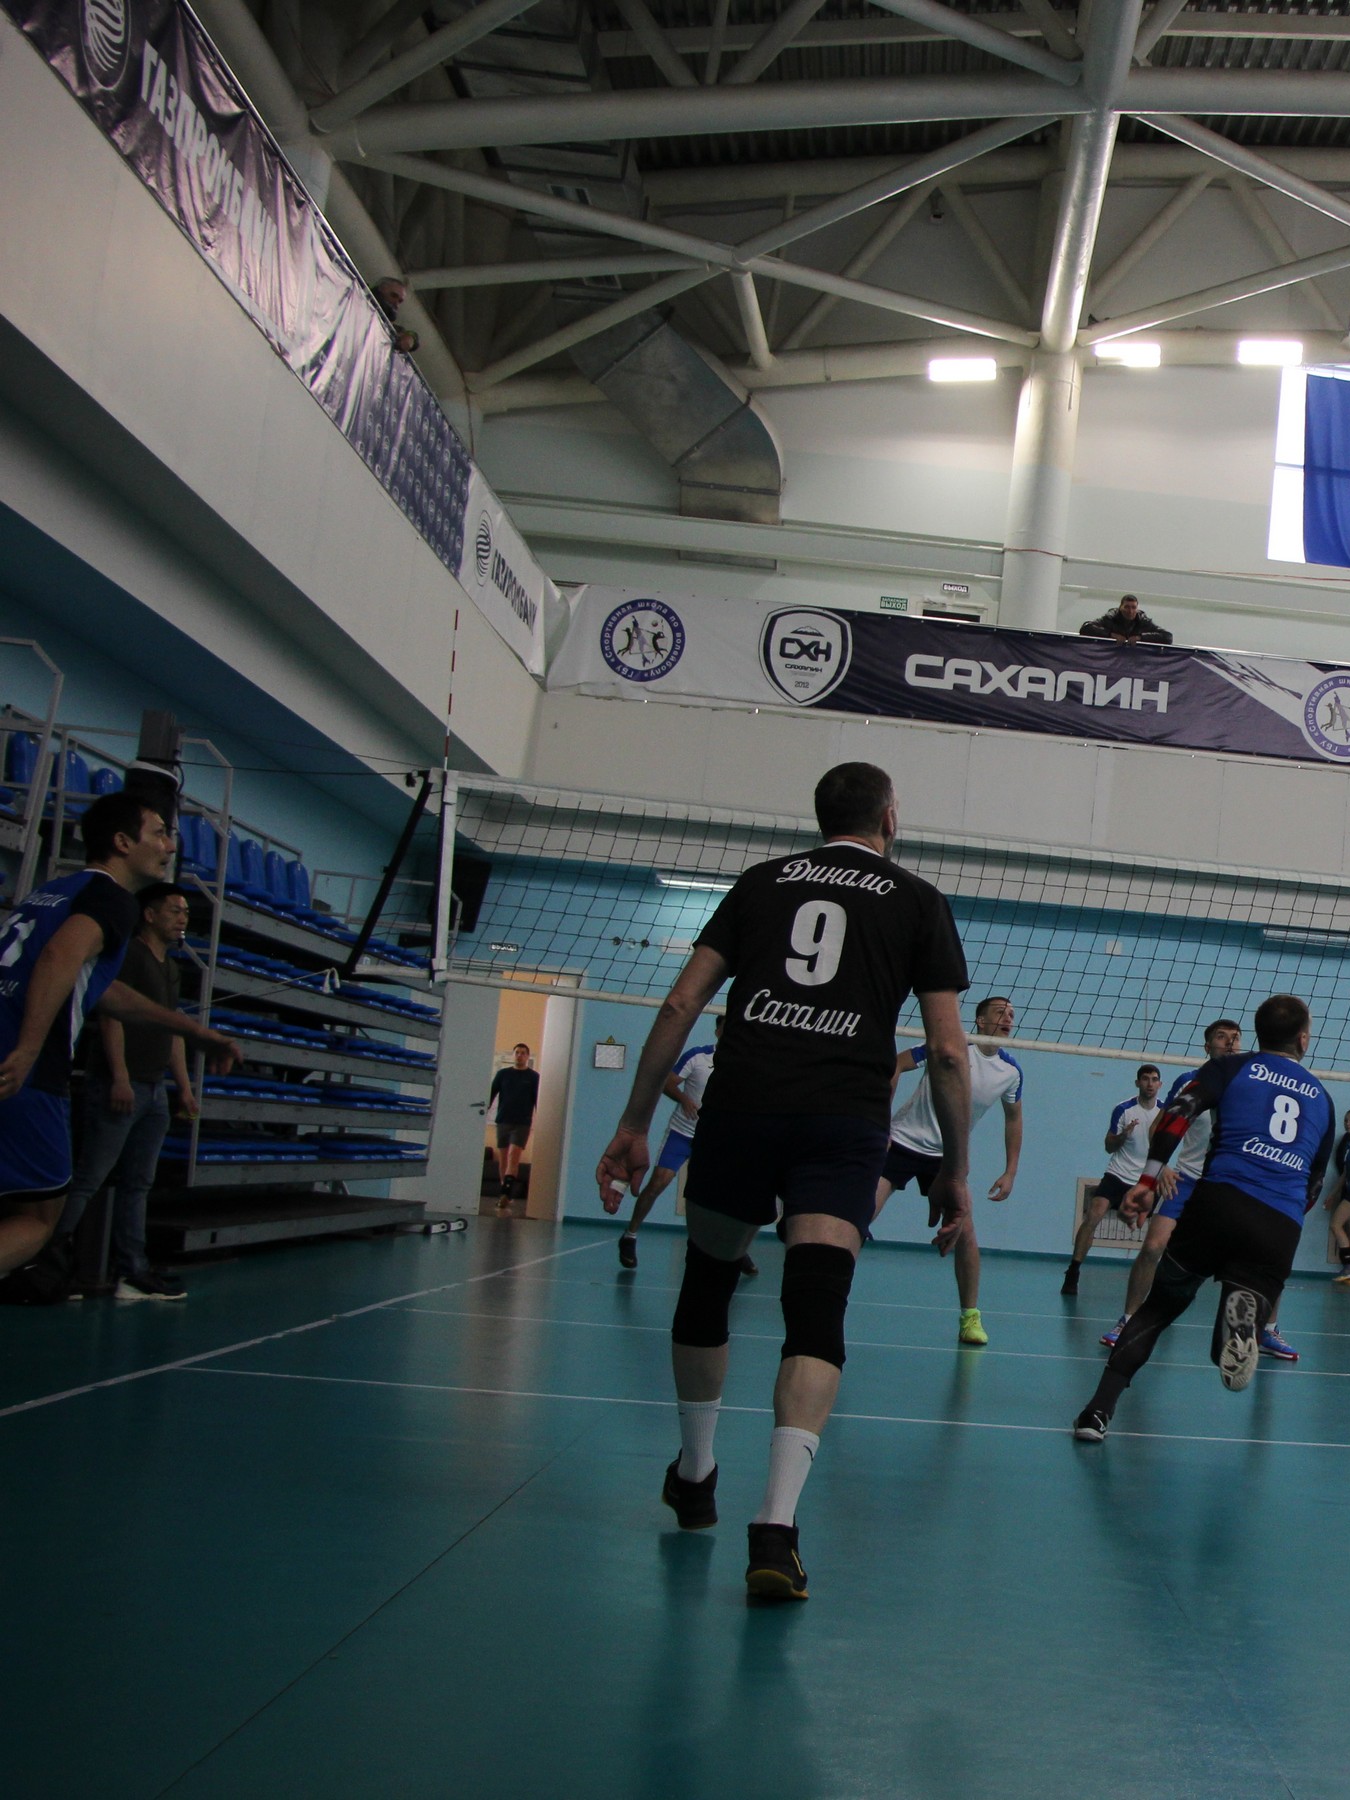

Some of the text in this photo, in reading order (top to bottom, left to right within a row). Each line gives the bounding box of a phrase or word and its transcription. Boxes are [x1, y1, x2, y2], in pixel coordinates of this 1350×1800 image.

[669, 615, 679, 627] по
[881, 601, 906, 610] ВЫХОД
[905, 653, 1169, 713] САХАЛИН
[776, 857, 897, 895] Динамо
[785, 900, 847, 986] 9
[743, 988, 862, 1037] Сахалин
[1249, 1063, 1320, 1099] Динамо
[1269, 1094, 1300, 1143] 8
[1242, 1137, 1304, 1170] Сахалин
